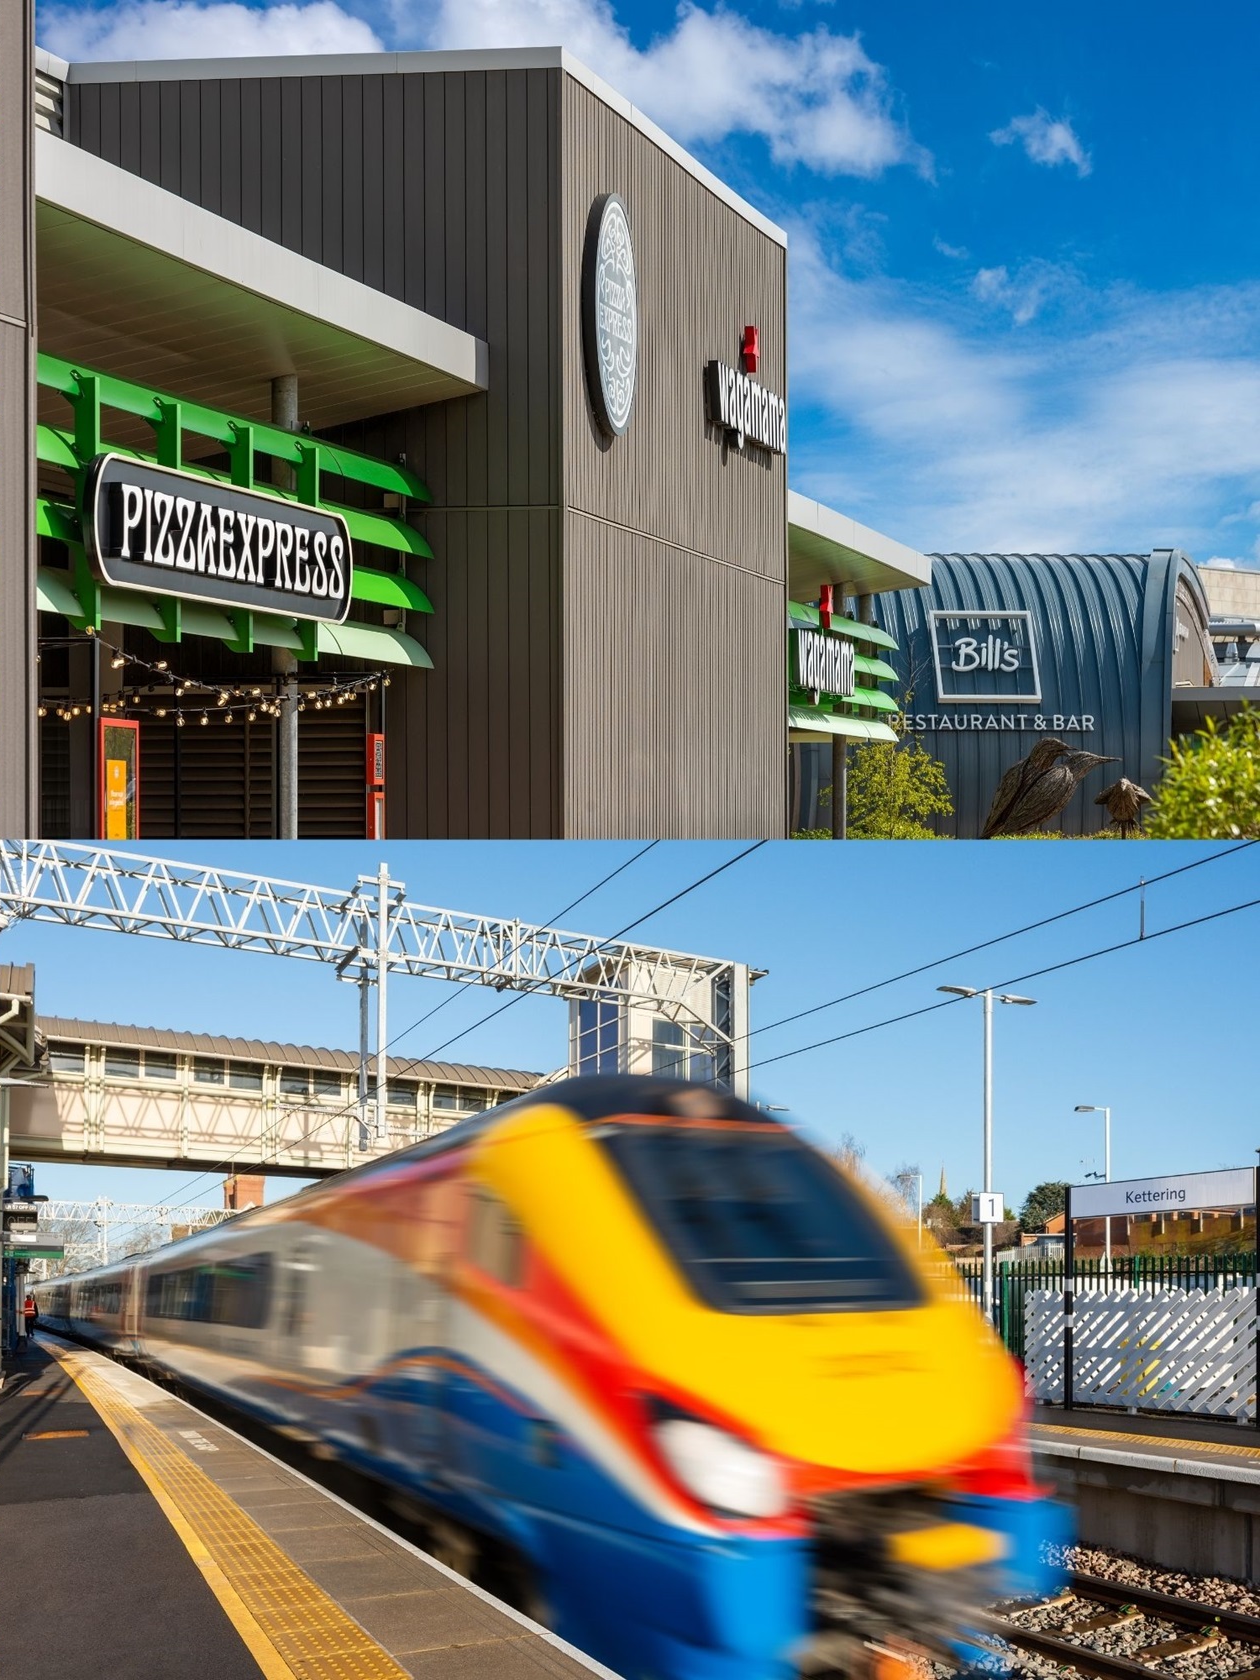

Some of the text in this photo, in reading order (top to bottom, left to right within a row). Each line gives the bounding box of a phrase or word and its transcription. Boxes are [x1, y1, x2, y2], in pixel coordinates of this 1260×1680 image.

[717, 361, 786, 454] wagamama
[121, 483, 344, 599] PIZZAEXPRESS
[798, 628, 855, 706] wagamama
[951, 634, 1020, 673] Bill's
[1033, 714, 1047, 731] &
[1053, 714, 1095, 731] BAR
[988, 1198, 994, 1217] 1
[1125, 1187, 1186, 1204] Kettering
